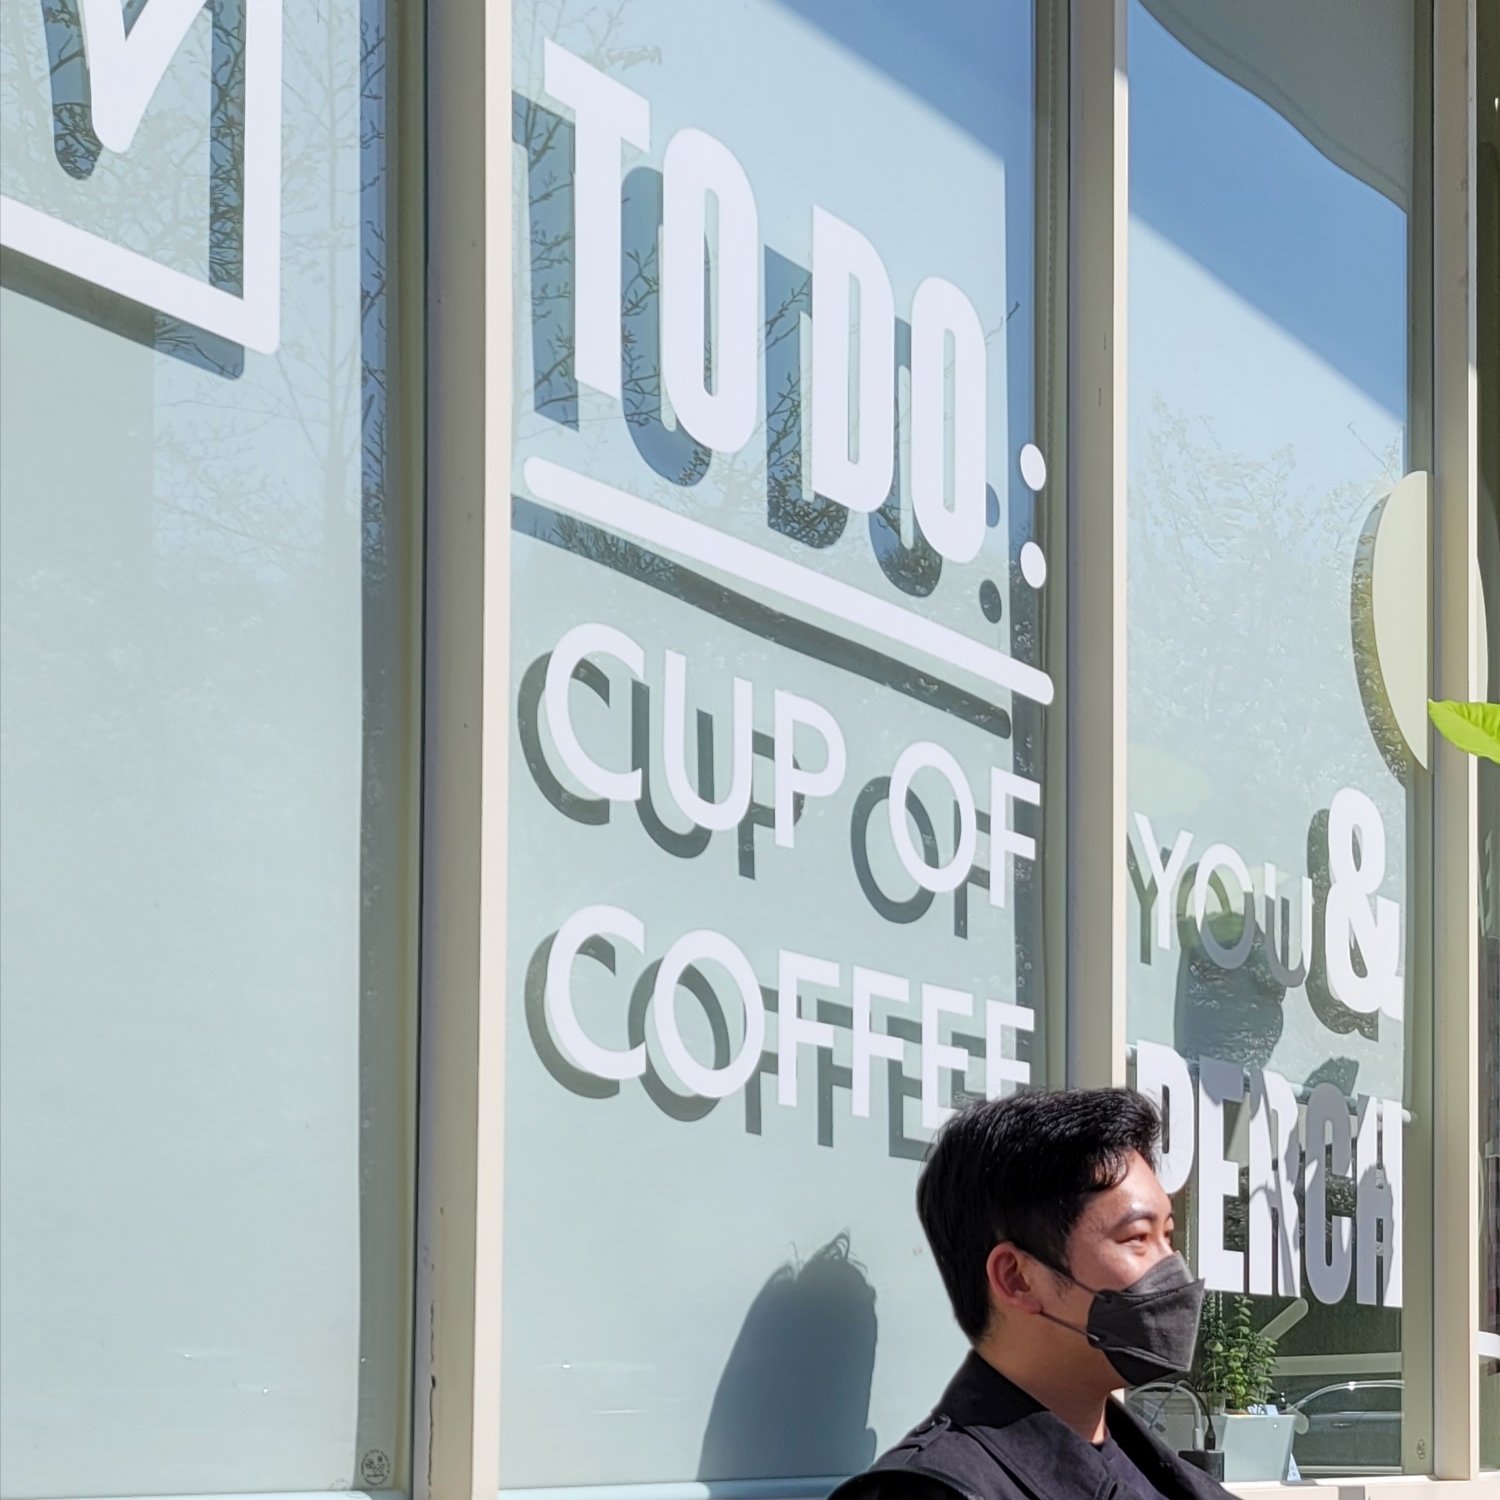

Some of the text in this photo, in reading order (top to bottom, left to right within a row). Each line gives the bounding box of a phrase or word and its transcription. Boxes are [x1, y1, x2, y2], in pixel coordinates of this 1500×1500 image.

[544, 37, 758, 454] TO
[545, 623, 1041, 908] CUP OF
[547, 904, 1035, 1131] COFFEE
[1133, 811, 1312, 988] YOU
[1325, 787, 1403, 1022] &
[1137, 1040, 1403, 1308] PERCH
